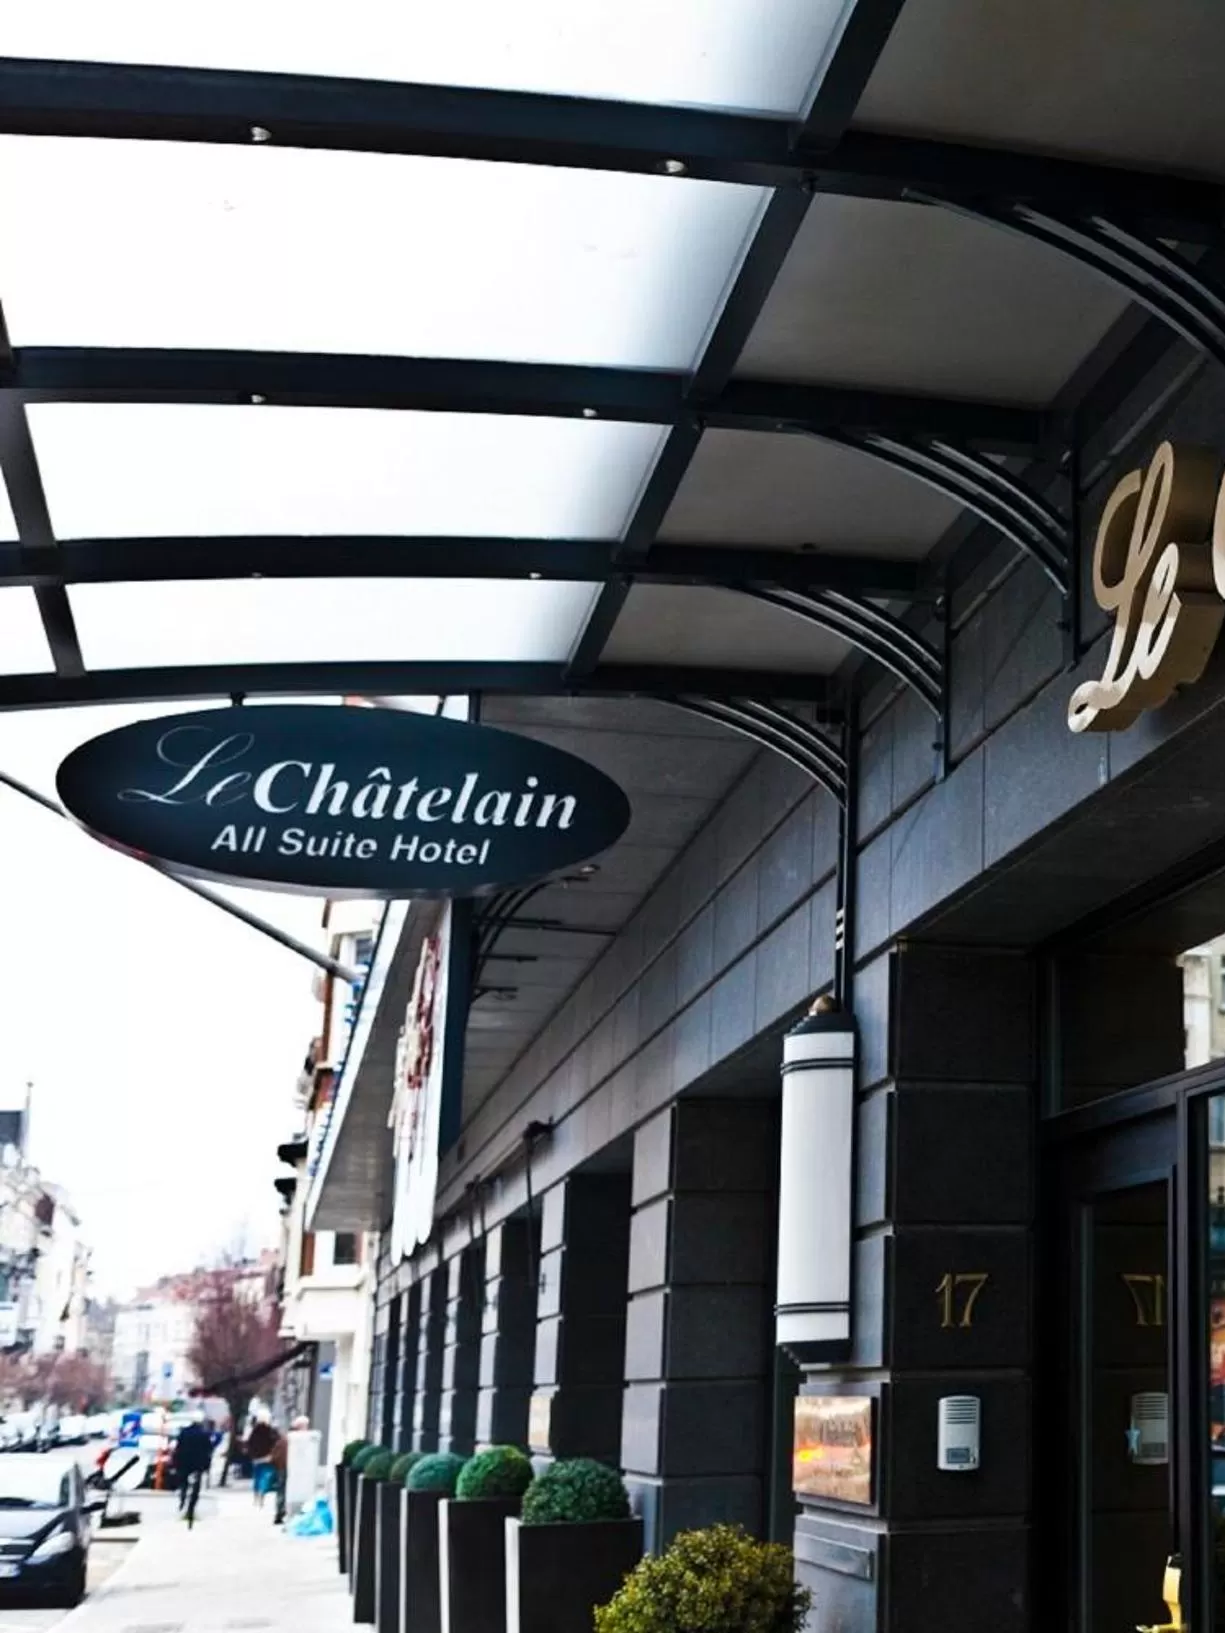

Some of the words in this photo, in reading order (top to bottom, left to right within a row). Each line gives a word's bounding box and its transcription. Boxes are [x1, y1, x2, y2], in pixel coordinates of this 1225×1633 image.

[1068, 441, 1182, 733] Le
[116, 725, 254, 806] Le
[253, 760, 577, 829] Châtelain
[211, 824, 266, 852] All
[278, 827, 378, 860] Suite
[390, 834, 491, 865] Hotel
[935, 1273, 989, 1328] 17
